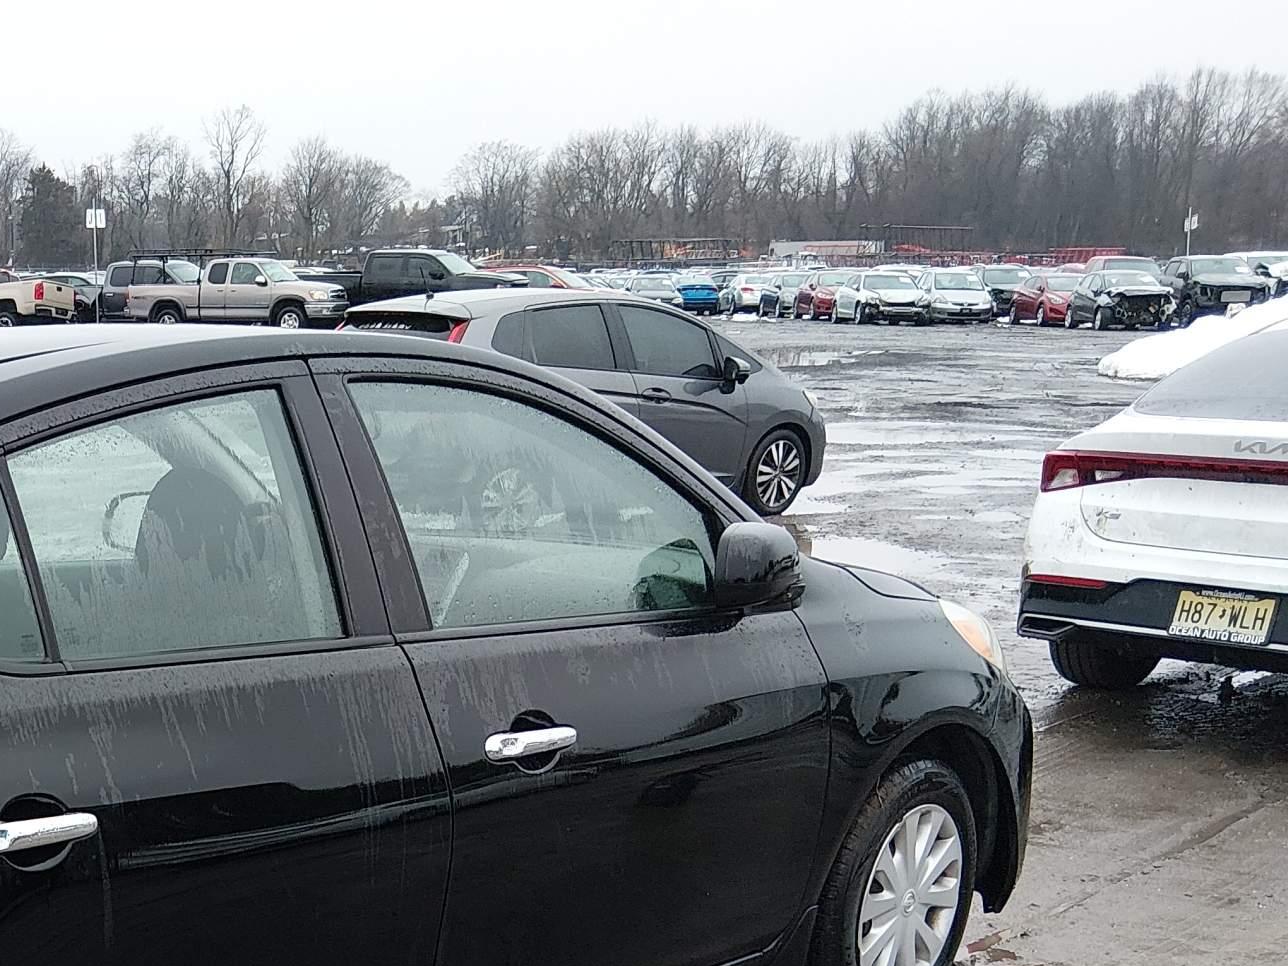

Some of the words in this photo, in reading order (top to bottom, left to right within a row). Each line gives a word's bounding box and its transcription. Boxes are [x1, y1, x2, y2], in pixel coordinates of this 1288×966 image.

[1178, 600, 1217, 625] H87
[1228, 605, 1268, 631] WLH
[1169, 625, 1201, 638] OCEAN
[1202, 629, 1229, 641] AUTO
[1230, 632, 1265, 645] GROUP
